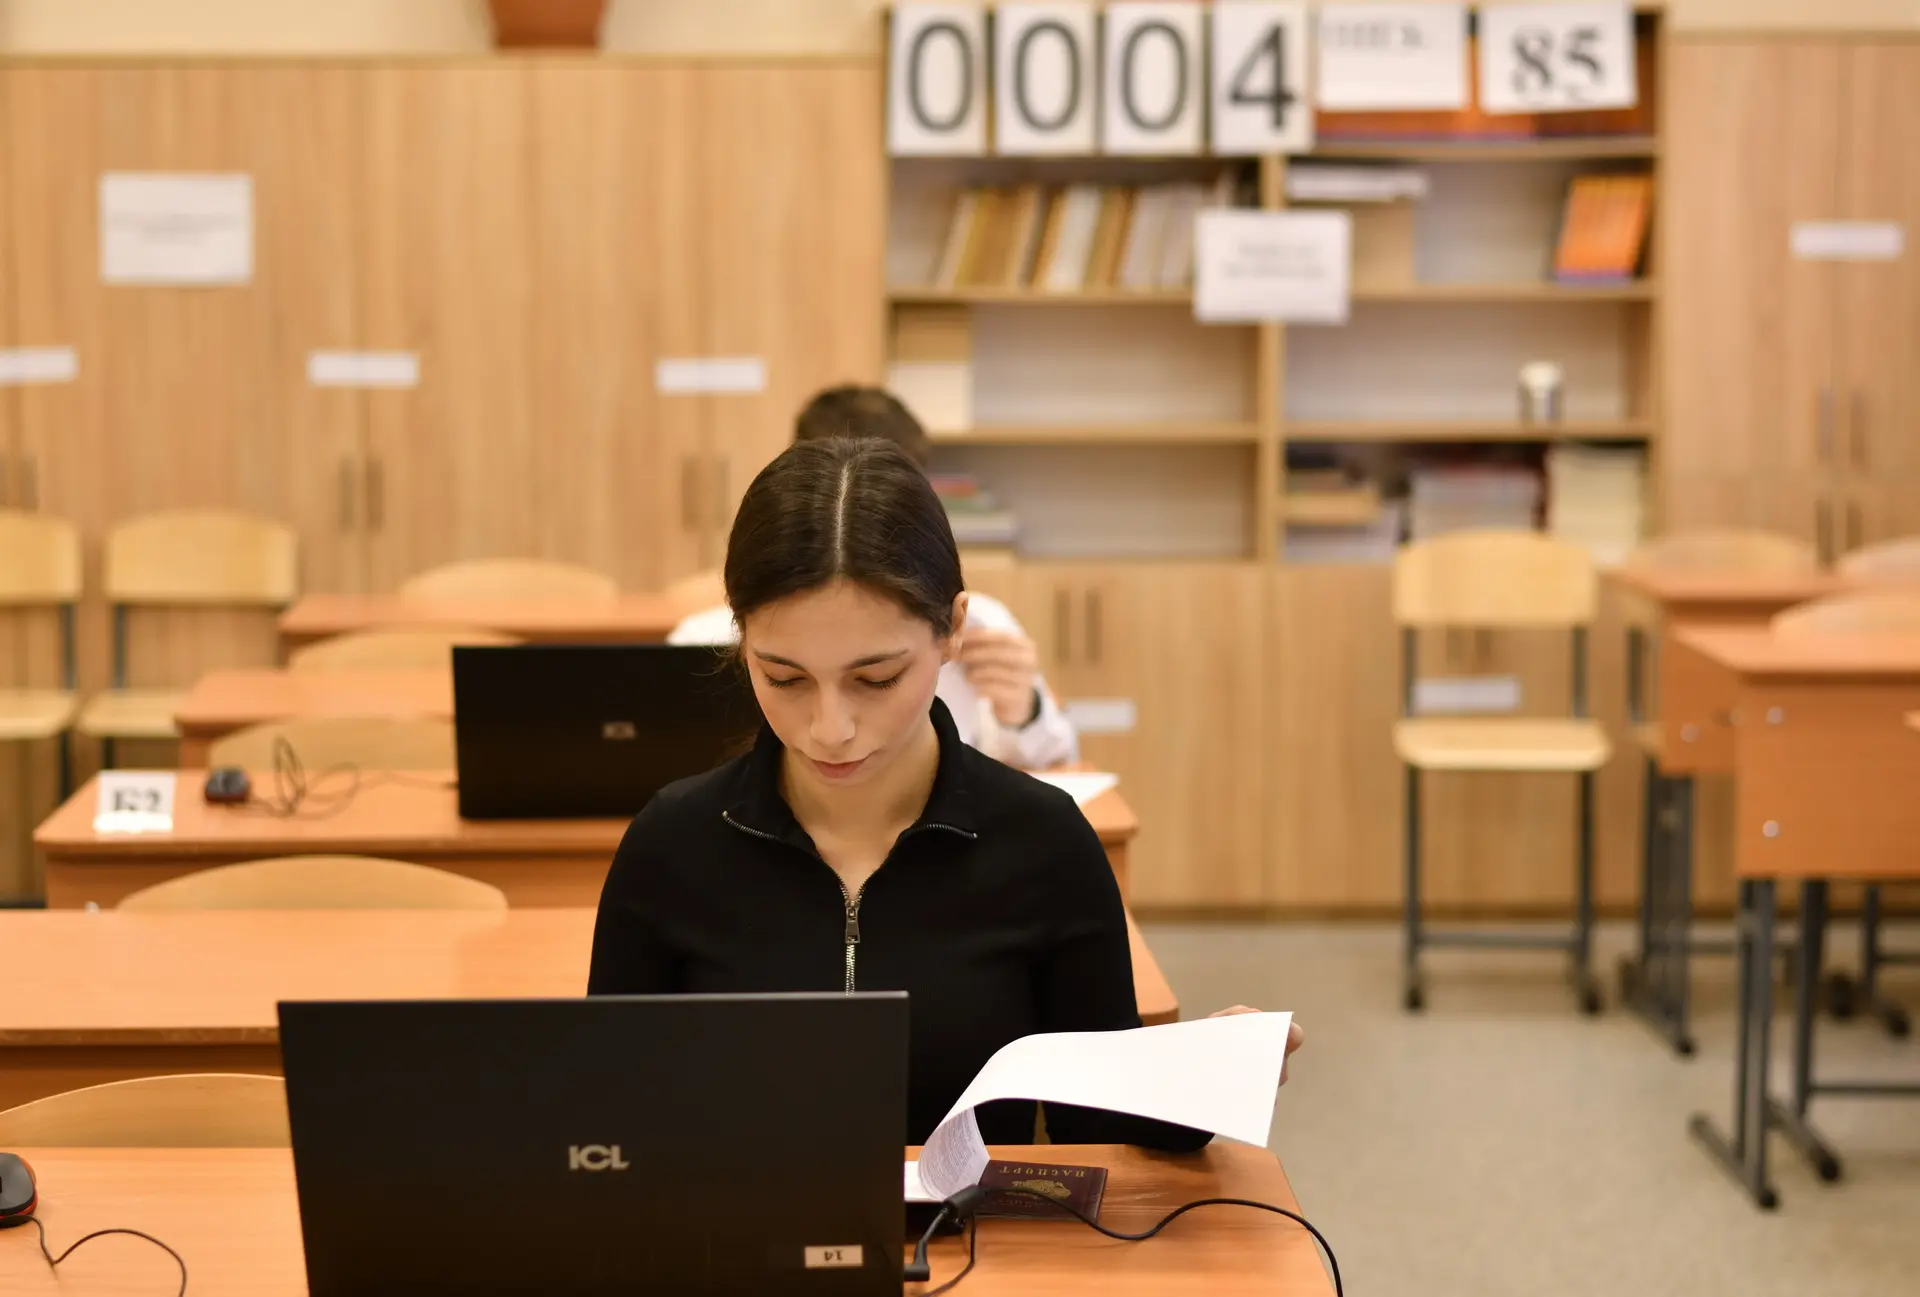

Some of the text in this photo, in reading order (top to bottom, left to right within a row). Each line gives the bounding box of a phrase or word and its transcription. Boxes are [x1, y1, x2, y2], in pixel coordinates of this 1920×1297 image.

[1511, 24, 1606, 103] 85
[569, 1144, 630, 1170] ICL
[999, 1164, 1086, 1178] ПАСПОРТ
[823, 1248, 843, 1262] 14
